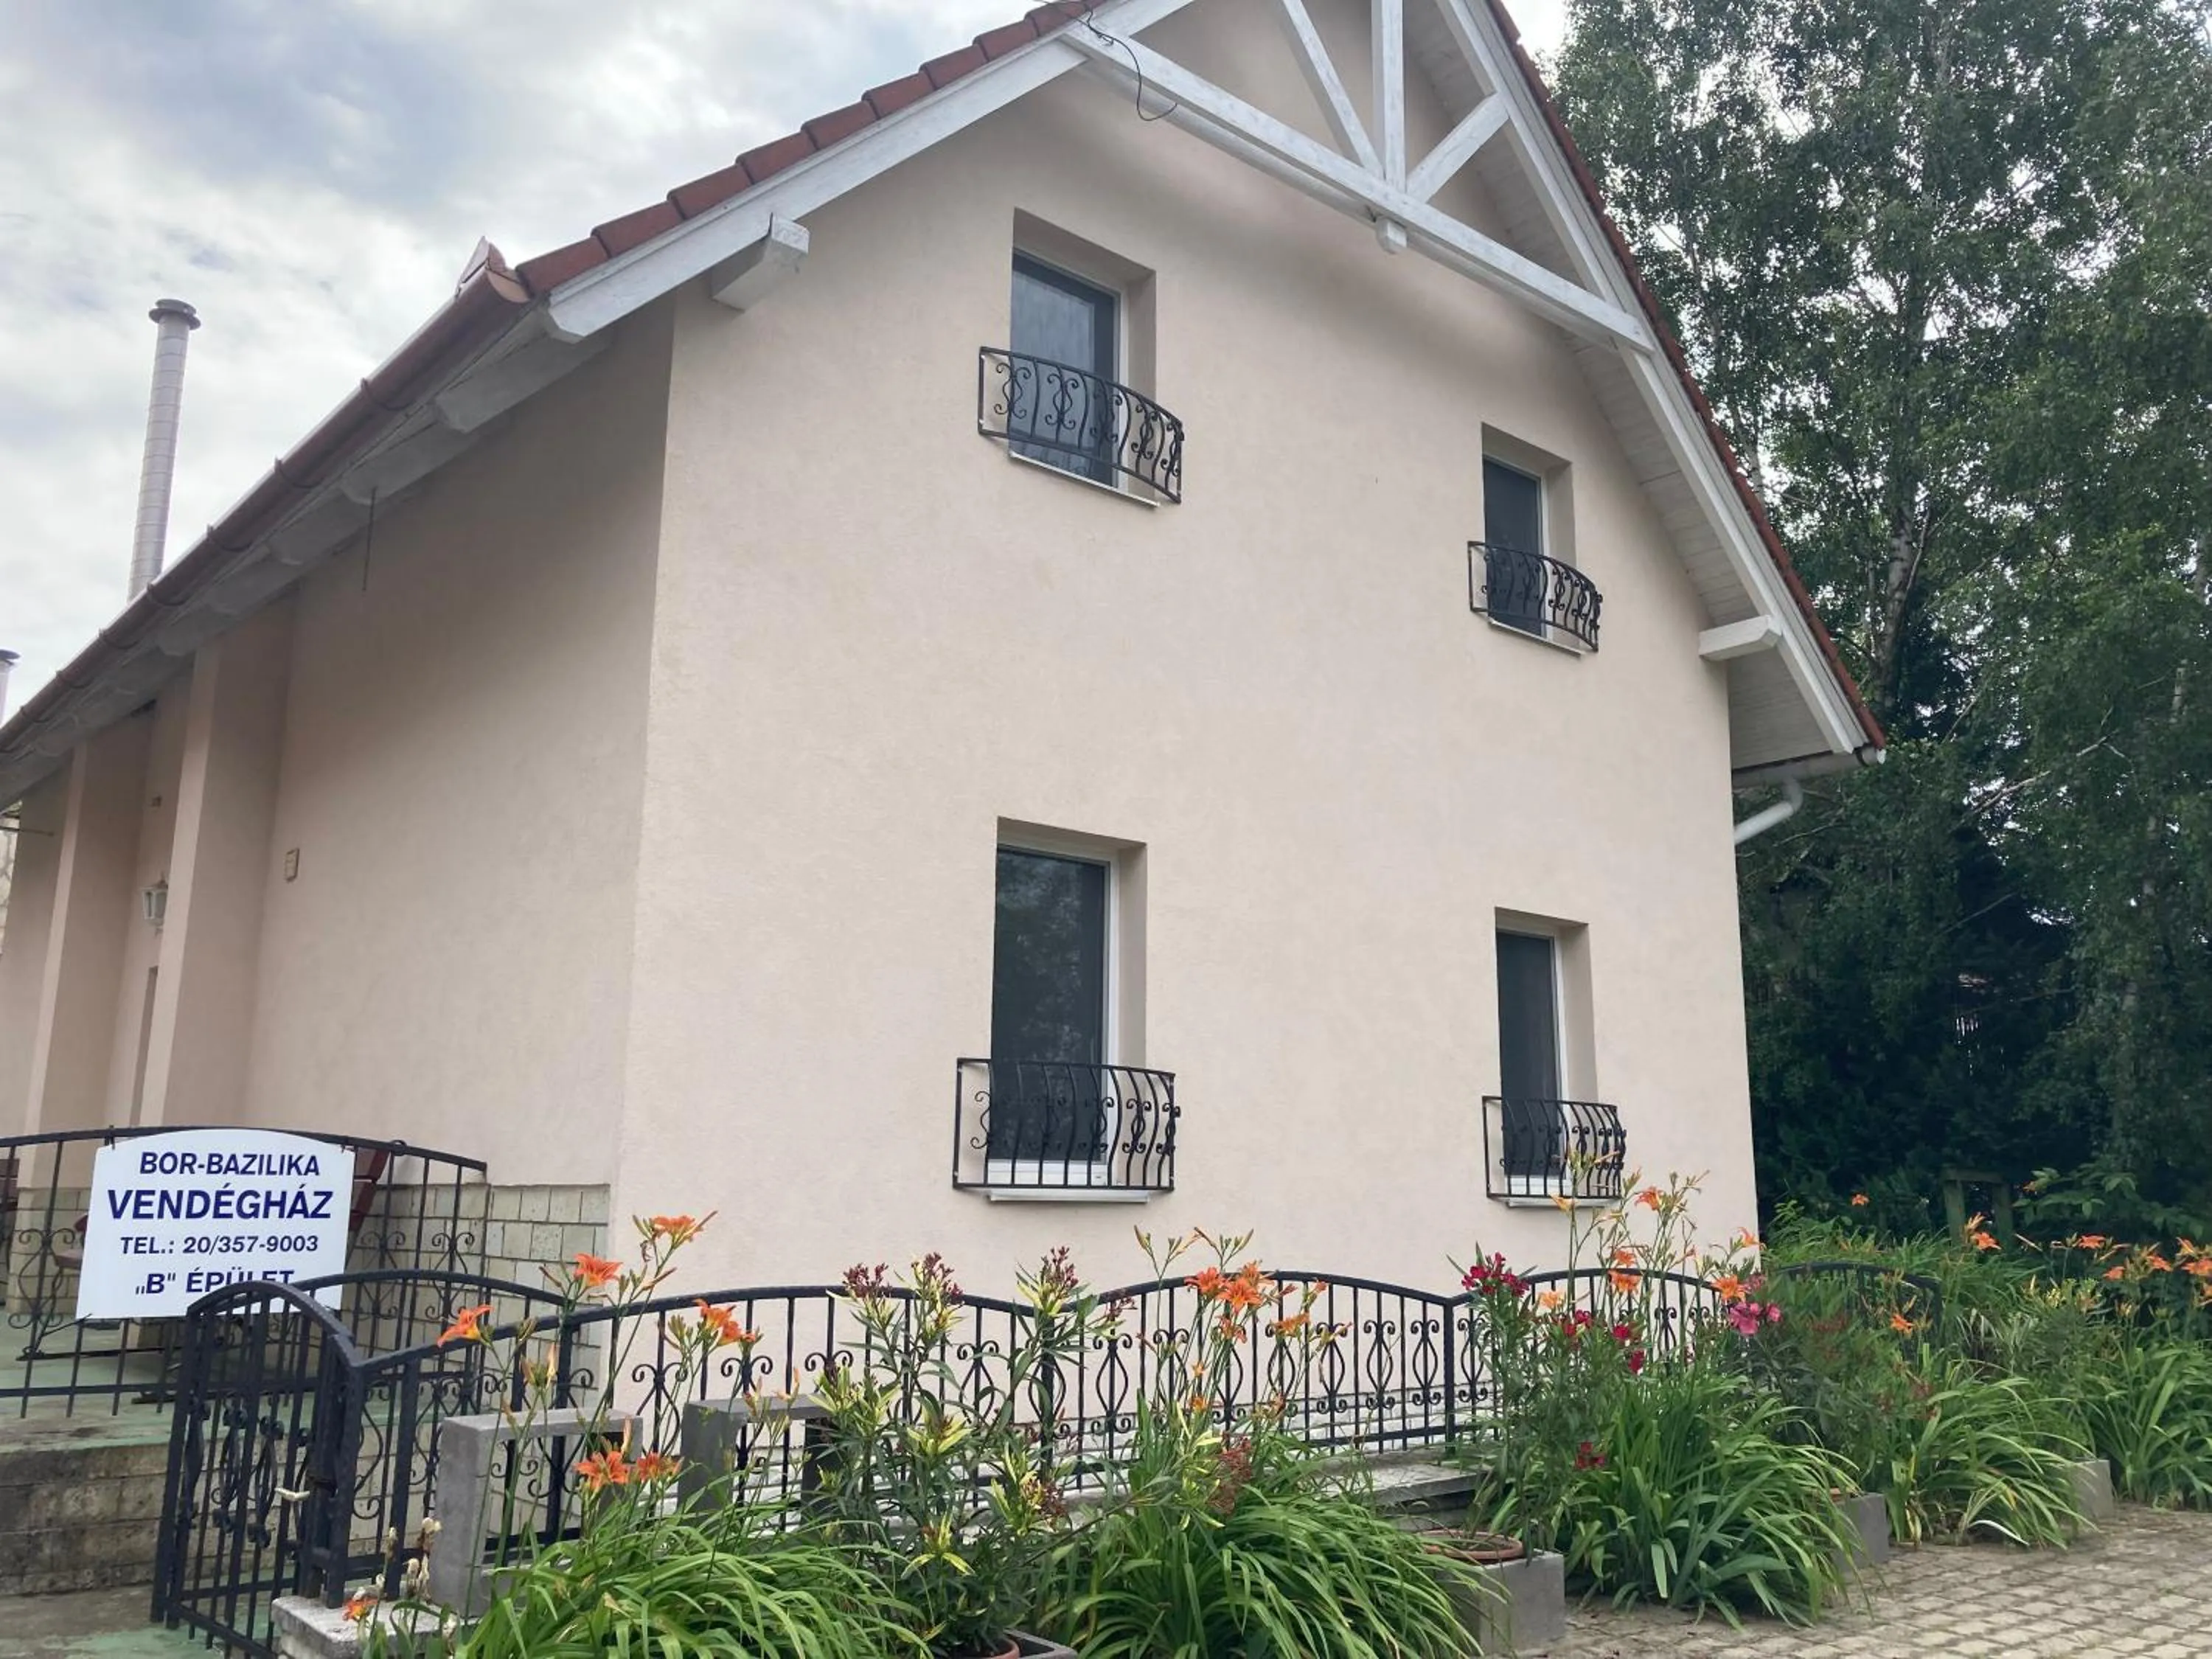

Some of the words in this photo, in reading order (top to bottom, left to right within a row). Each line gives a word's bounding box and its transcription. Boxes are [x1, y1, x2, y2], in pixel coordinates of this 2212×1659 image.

[139, 1151, 320, 1177] BOR-BAZILIKA
[107, 1183, 333, 1220] VENDÉGHÁZ
[120, 1237, 174, 1254] TEL.:
[183, 1235, 319, 1256] 20/357-9003
